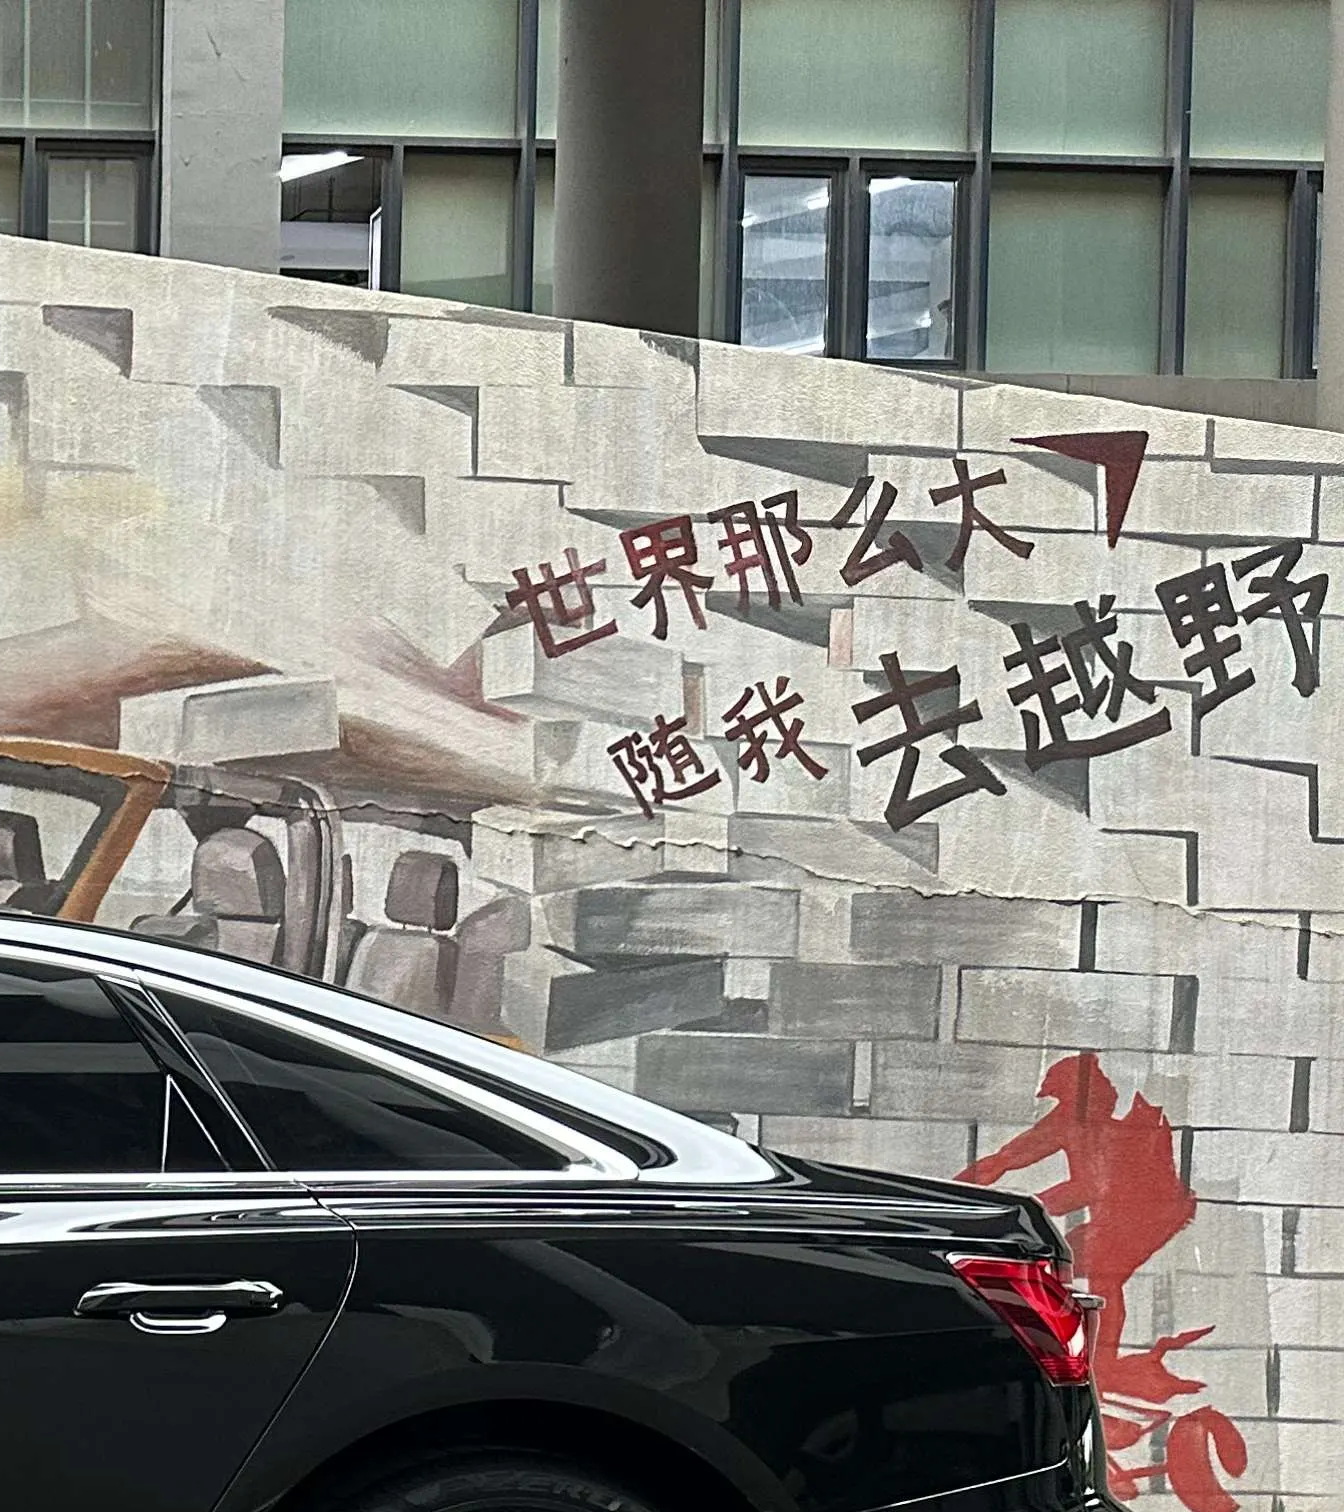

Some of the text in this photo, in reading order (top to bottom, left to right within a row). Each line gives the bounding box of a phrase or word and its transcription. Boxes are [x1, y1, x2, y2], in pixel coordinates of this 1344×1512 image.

[505, 458, 1036, 659] 世界那么大
[606, 539, 1330, 832] 随我去越野
